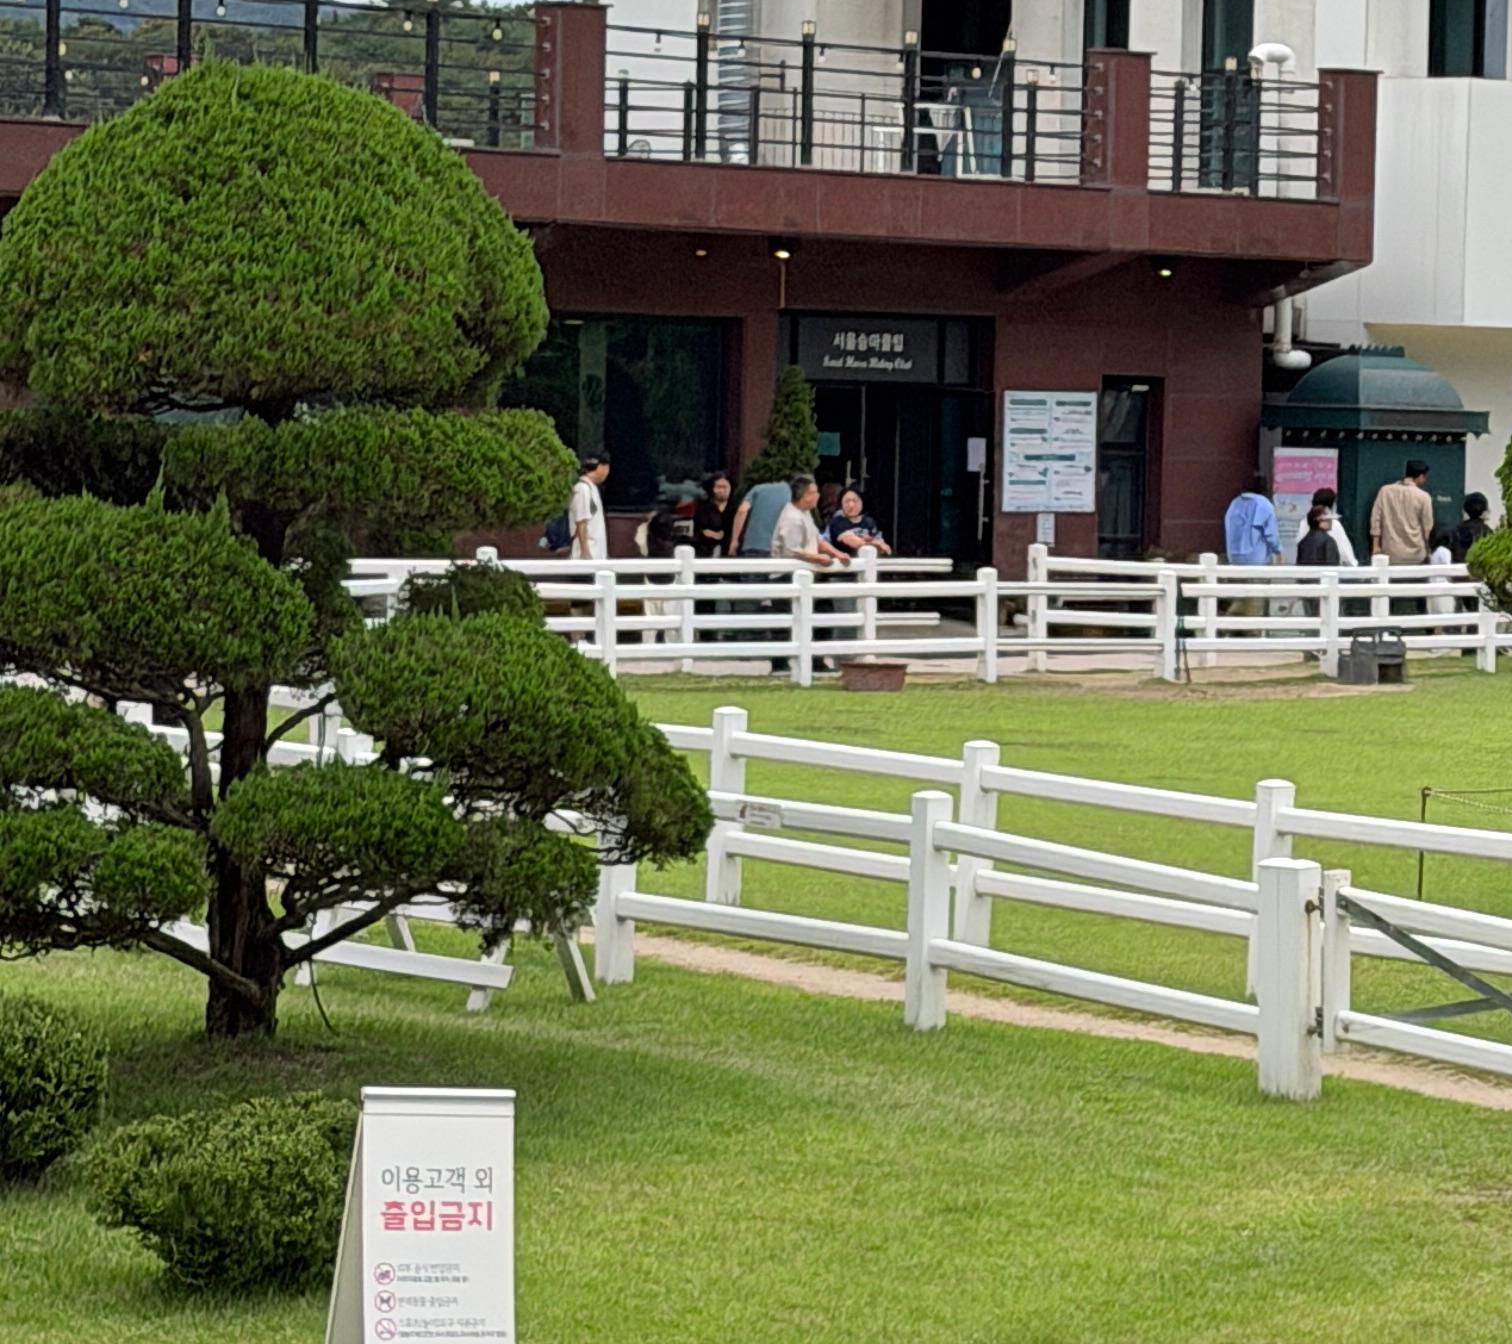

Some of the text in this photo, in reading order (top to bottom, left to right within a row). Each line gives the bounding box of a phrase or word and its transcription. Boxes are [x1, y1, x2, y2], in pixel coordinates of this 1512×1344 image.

[381, 1165, 494, 1194] 이용고객 외
[380, 1199, 494, 1232] 출입금지
